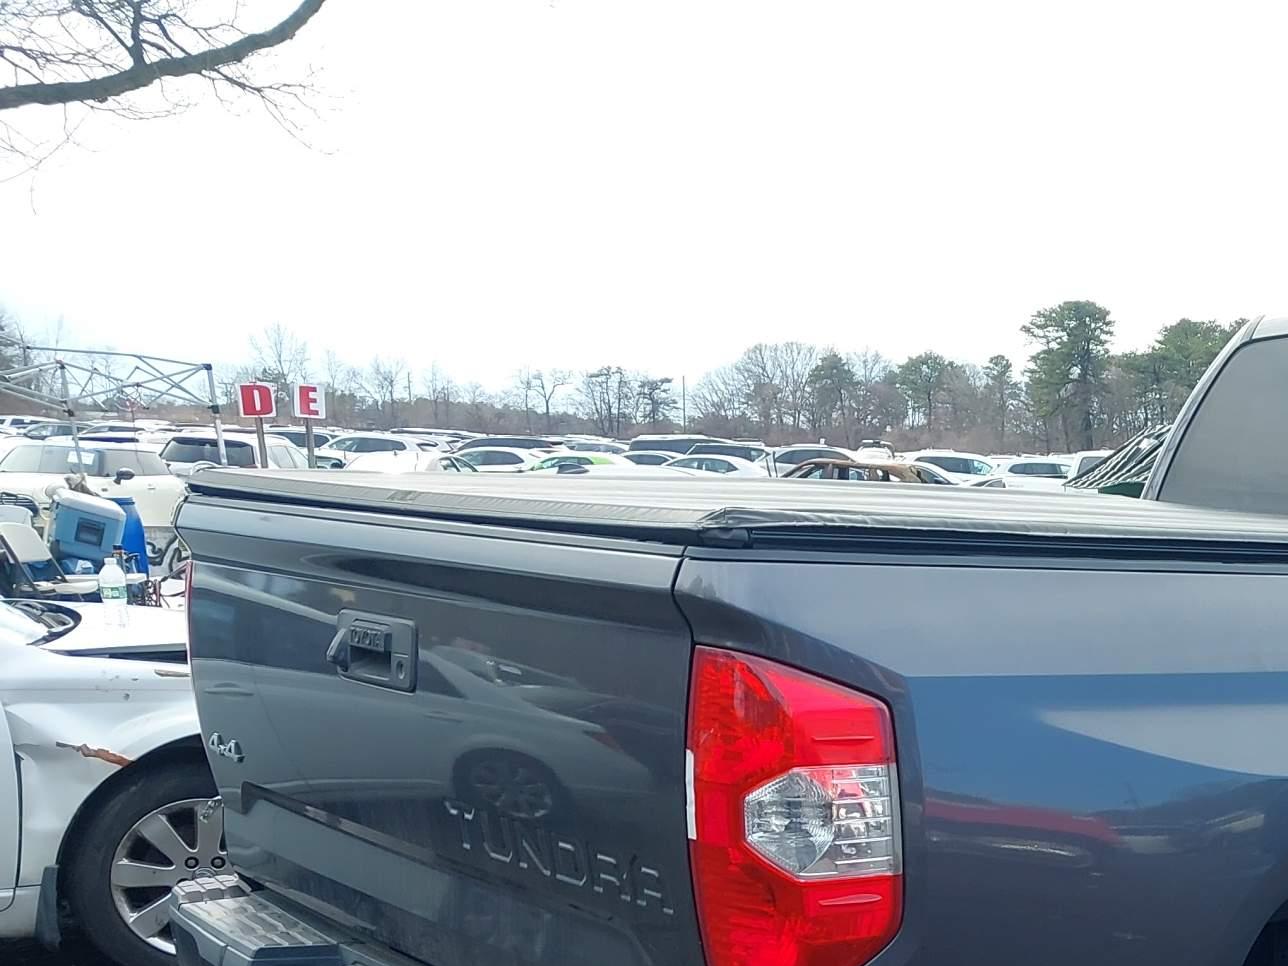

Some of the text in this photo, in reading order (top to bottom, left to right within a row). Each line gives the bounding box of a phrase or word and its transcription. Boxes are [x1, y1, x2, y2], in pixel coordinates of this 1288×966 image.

[240, 384, 273, 416] D
[299, 383, 319, 416] E
[445, 801, 675, 916] TUNDRA
